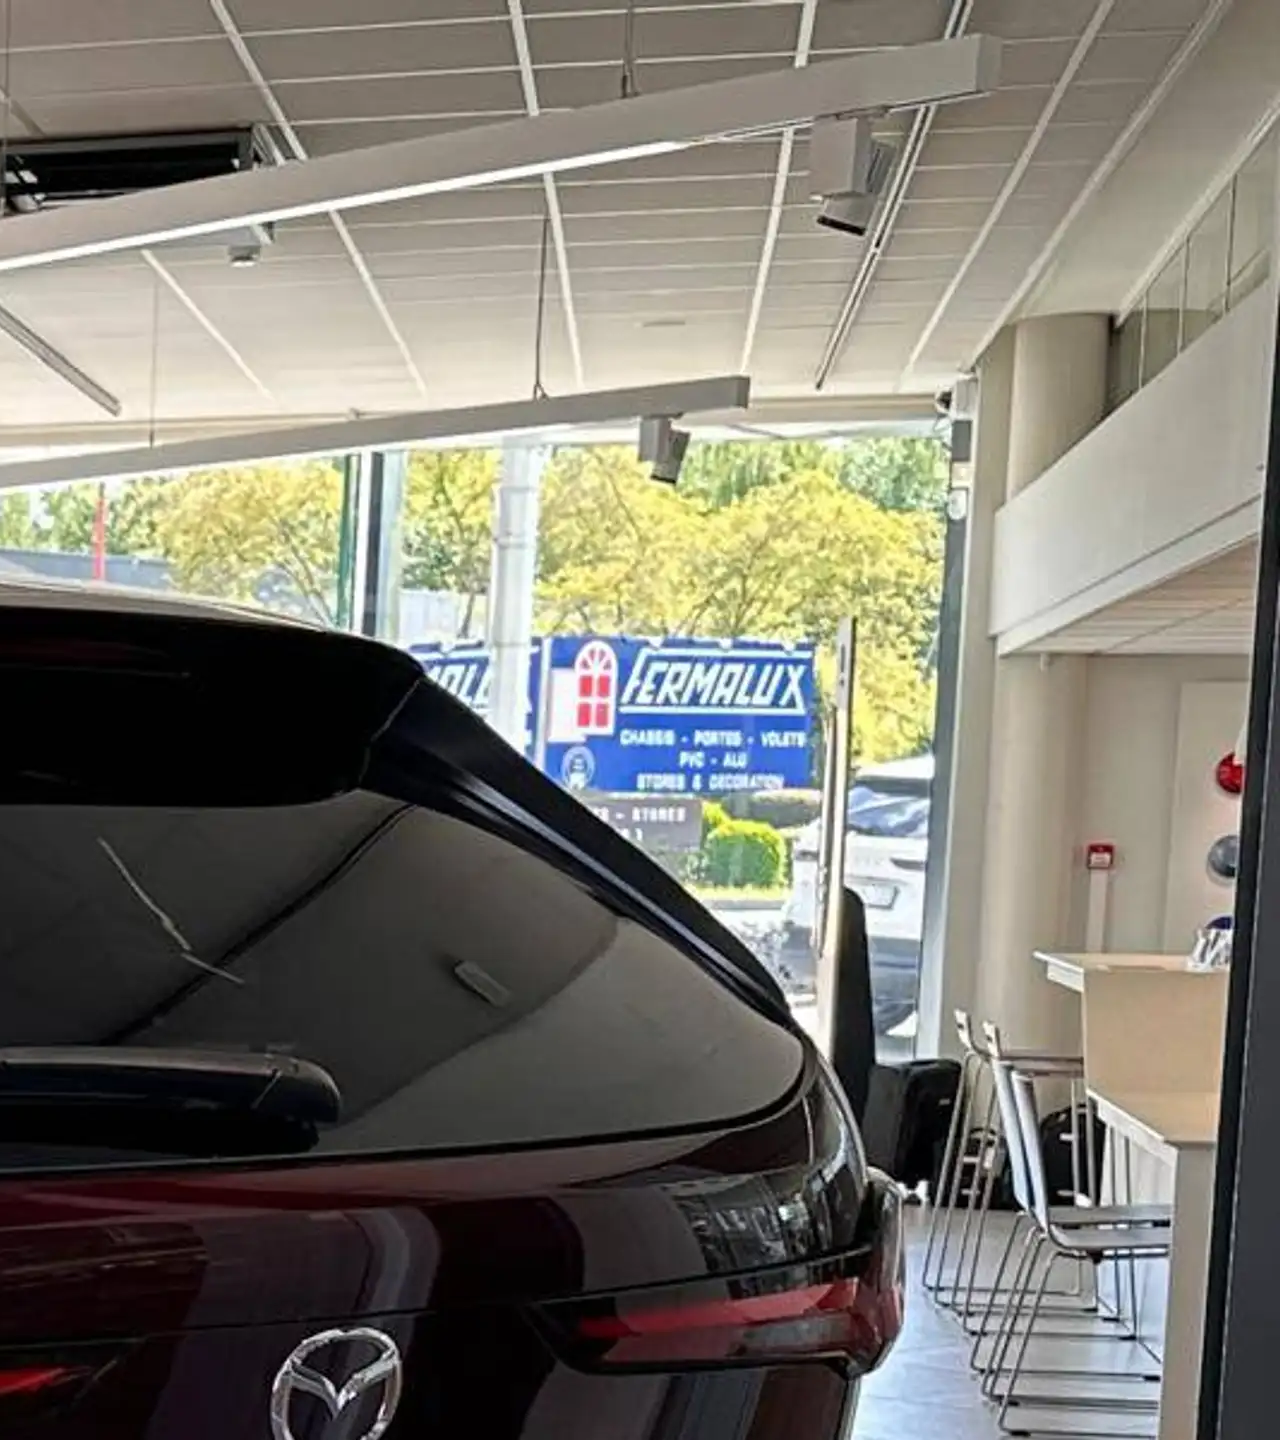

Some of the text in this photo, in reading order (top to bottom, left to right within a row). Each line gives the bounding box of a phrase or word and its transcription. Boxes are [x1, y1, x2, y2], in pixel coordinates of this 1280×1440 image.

[619, 650, 808, 711] FERMALUX
[678, 751, 748, 769] PVC ALU
